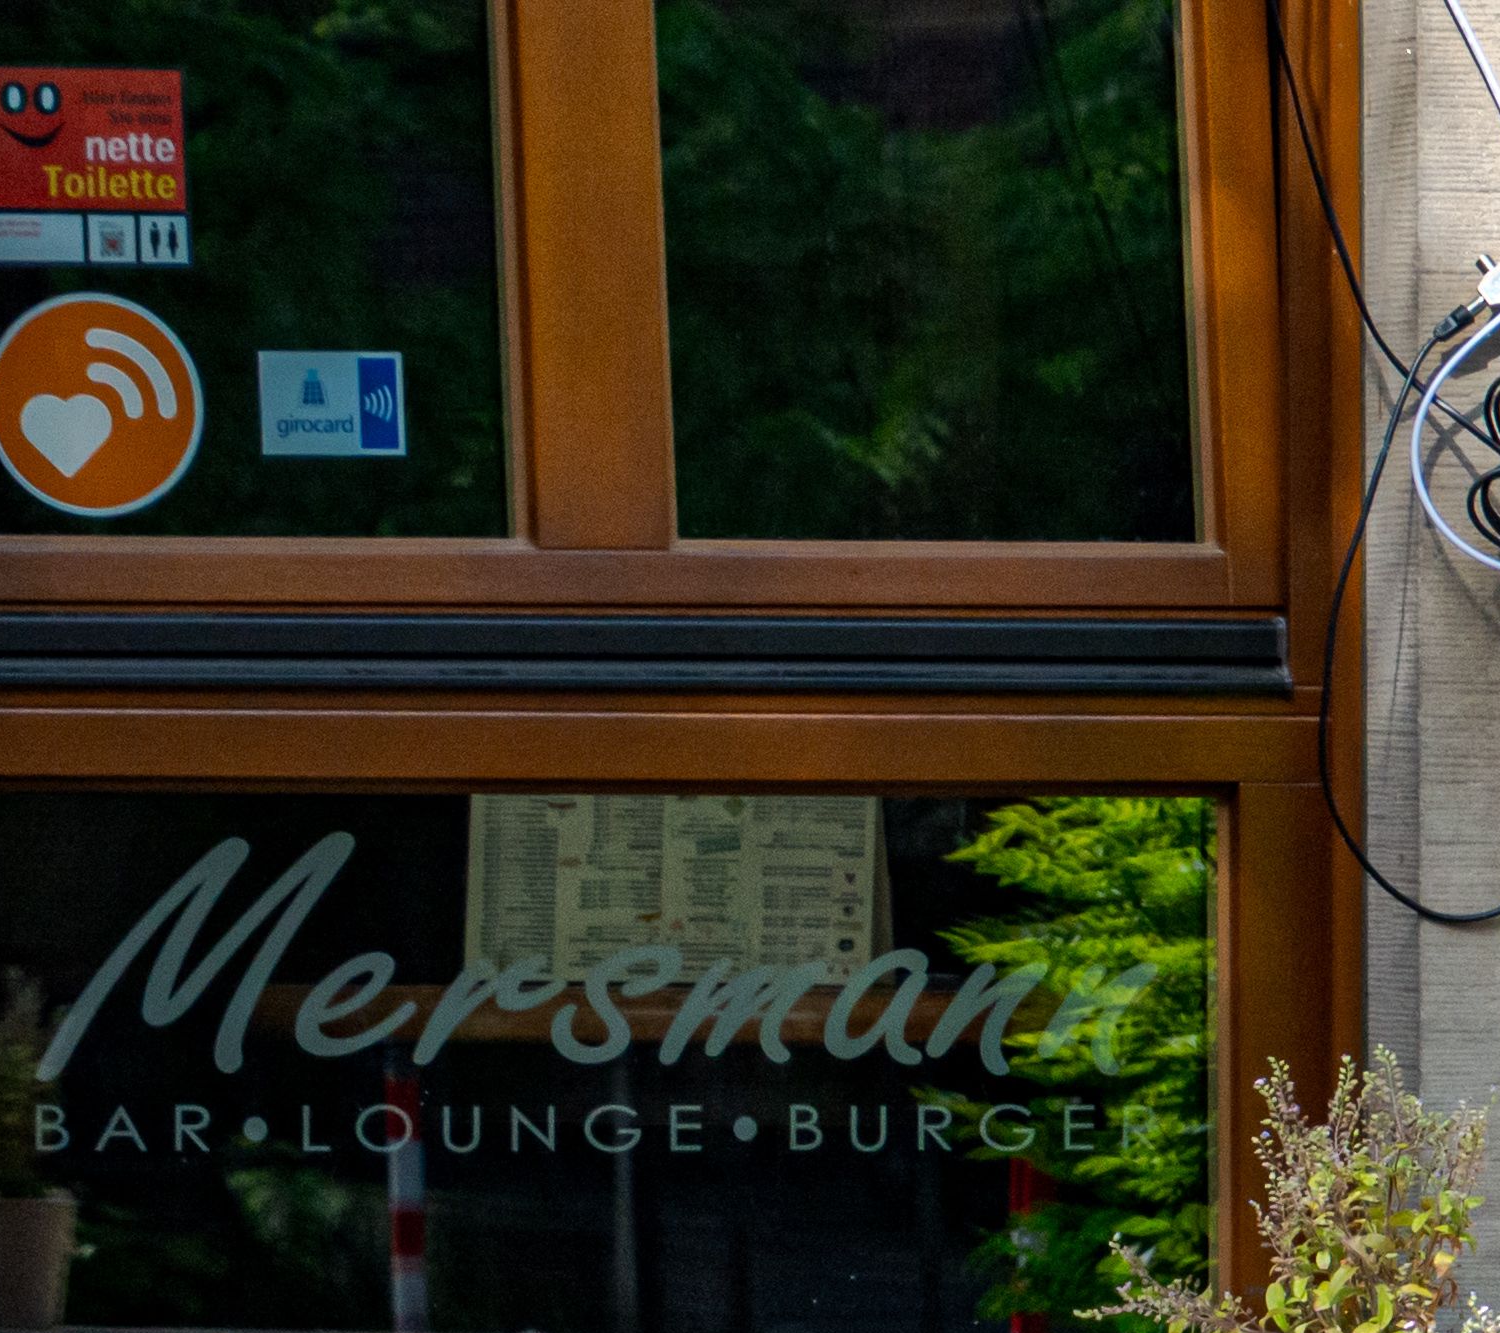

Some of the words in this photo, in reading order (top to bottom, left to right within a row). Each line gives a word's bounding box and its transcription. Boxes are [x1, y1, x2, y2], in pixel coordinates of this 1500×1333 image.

[85, 132, 176, 164] nette
[42, 164, 178, 200] Toilette
[276, 413, 355, 438] girocard
[36, 830, 1160, 1082] Mersmann
[34, 1103, 212, 1153] BAR
[301, 1102, 706, 1154] LOUNGE
[788, 1102, 1157, 1154] BURGER
